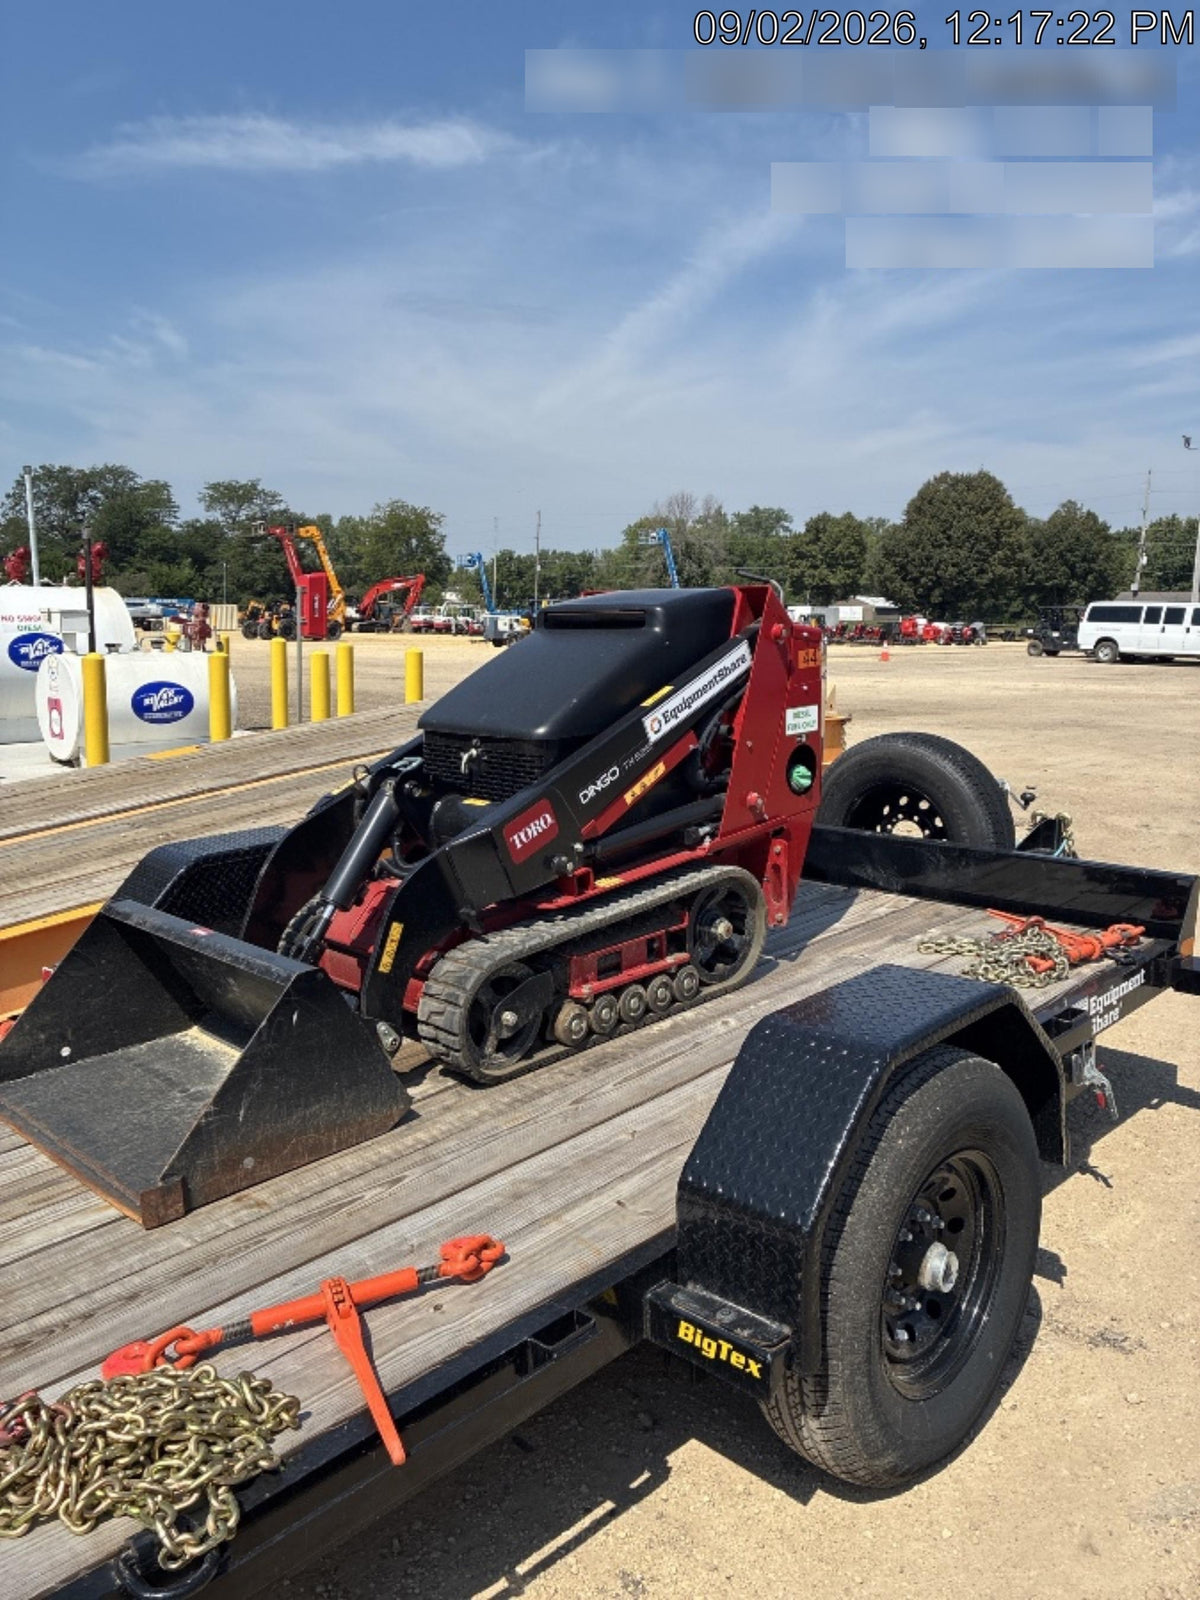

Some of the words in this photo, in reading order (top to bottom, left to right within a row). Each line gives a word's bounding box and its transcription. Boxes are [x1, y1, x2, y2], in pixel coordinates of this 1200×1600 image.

[661, 653, 748, 724] EquipmentShare
[579, 765, 620, 805] DINGO
[510, 813, 552, 849] TORO
[1089, 967, 1146, 1016] Equipment
[677, 1320, 762, 1379] BigTex
